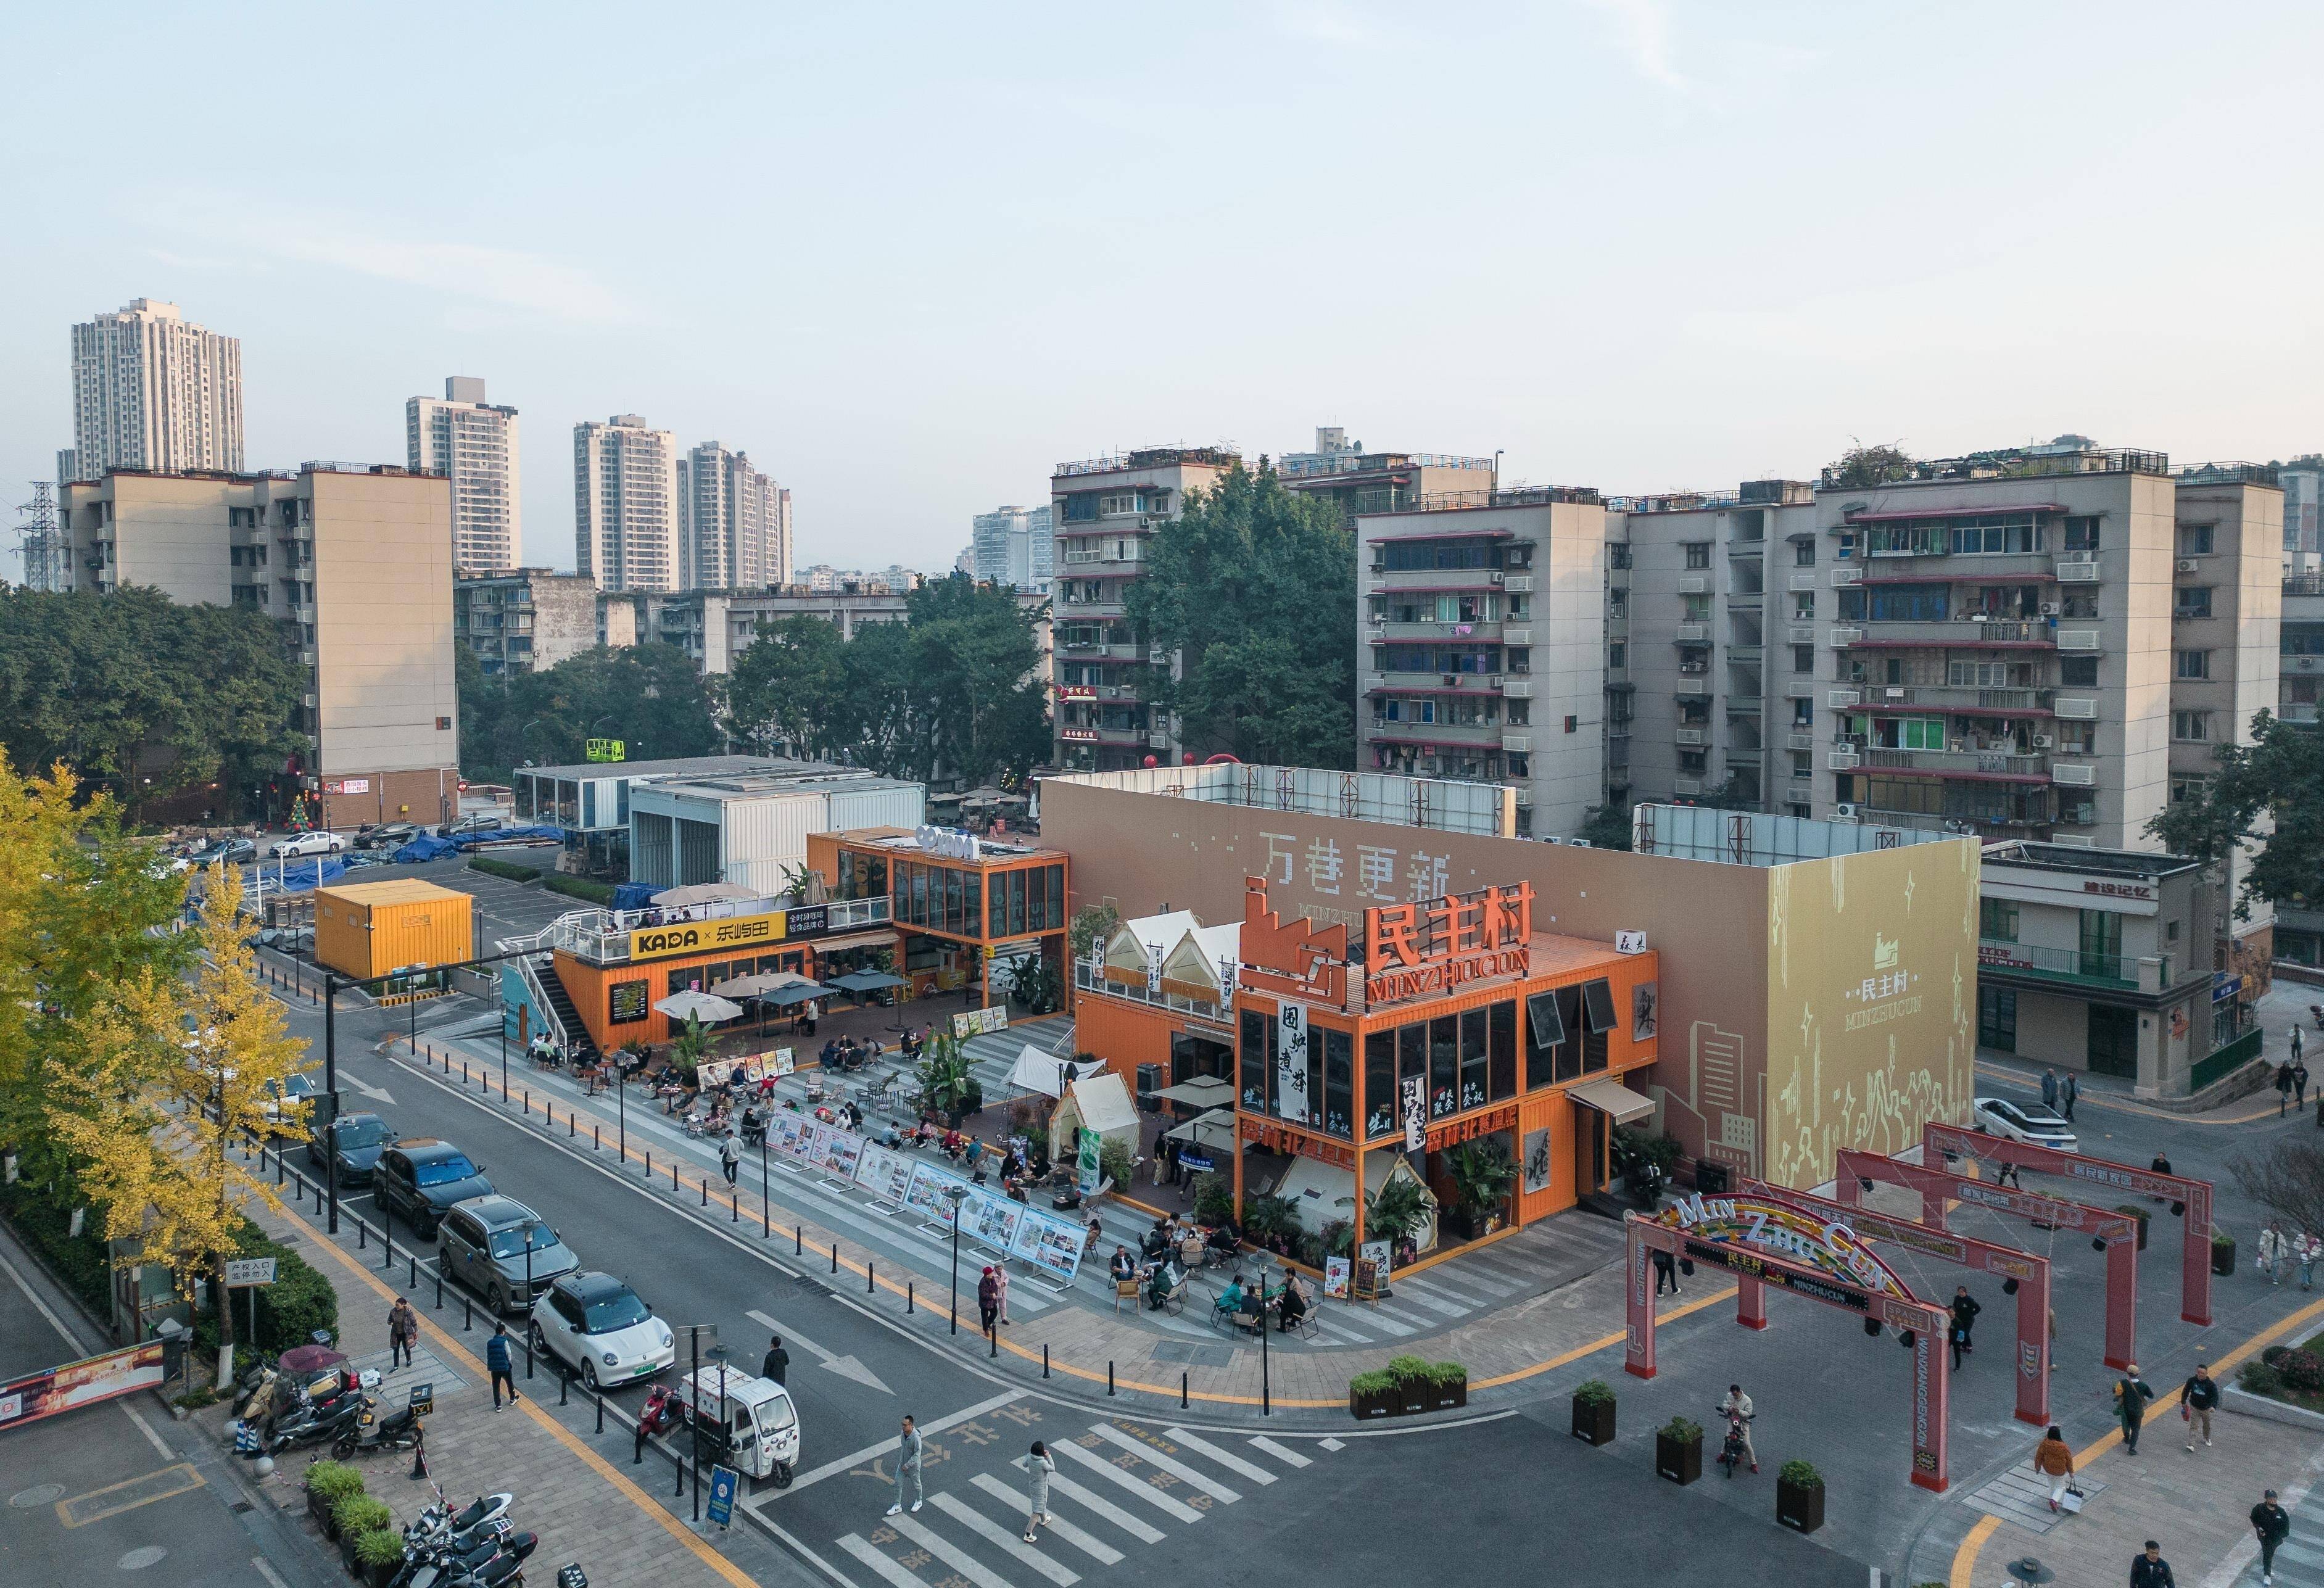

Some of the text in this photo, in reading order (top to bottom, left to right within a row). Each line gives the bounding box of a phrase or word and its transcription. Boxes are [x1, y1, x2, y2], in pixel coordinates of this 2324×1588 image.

[1260, 831, 1451, 909] 万巷更新
[2084, 881, 2150, 898] 建设记忆
[788, 910, 824, 922] 全时段咖啡
[1298, 903, 1364, 928] MINZHU
[1365, 880, 1537, 975] 民主村
[639, 929, 698, 953] KADA
[716, 920, 769, 942] 乐屿田
[1366, 948, 1530, 1004] MINZHUCUN
[1862, 969, 1908, 1003] 民主村
[1845, 995, 1922, 1032] MINZHUCUN
[1278, 1005, 1307, 1093] 围炉煮茶
[1368, 1112, 1391, 1135] 生日
[2075, 1164, 2132, 1186] 居民新家园
[1671, 1191, 1893, 1291] MIN ZHU CUN
[232, 1262, 269, 1272] 产权入口
[1637, 1241, 1645, 1307] MINZHUCUN
[1728, 1251, 1762, 1271] 民主村
[232, 1270, 270, 1280] 临停勿入
[1793, 1278, 1846, 1304] MINZHUCUN
[1888, 1305, 1924, 1322] SPACE
